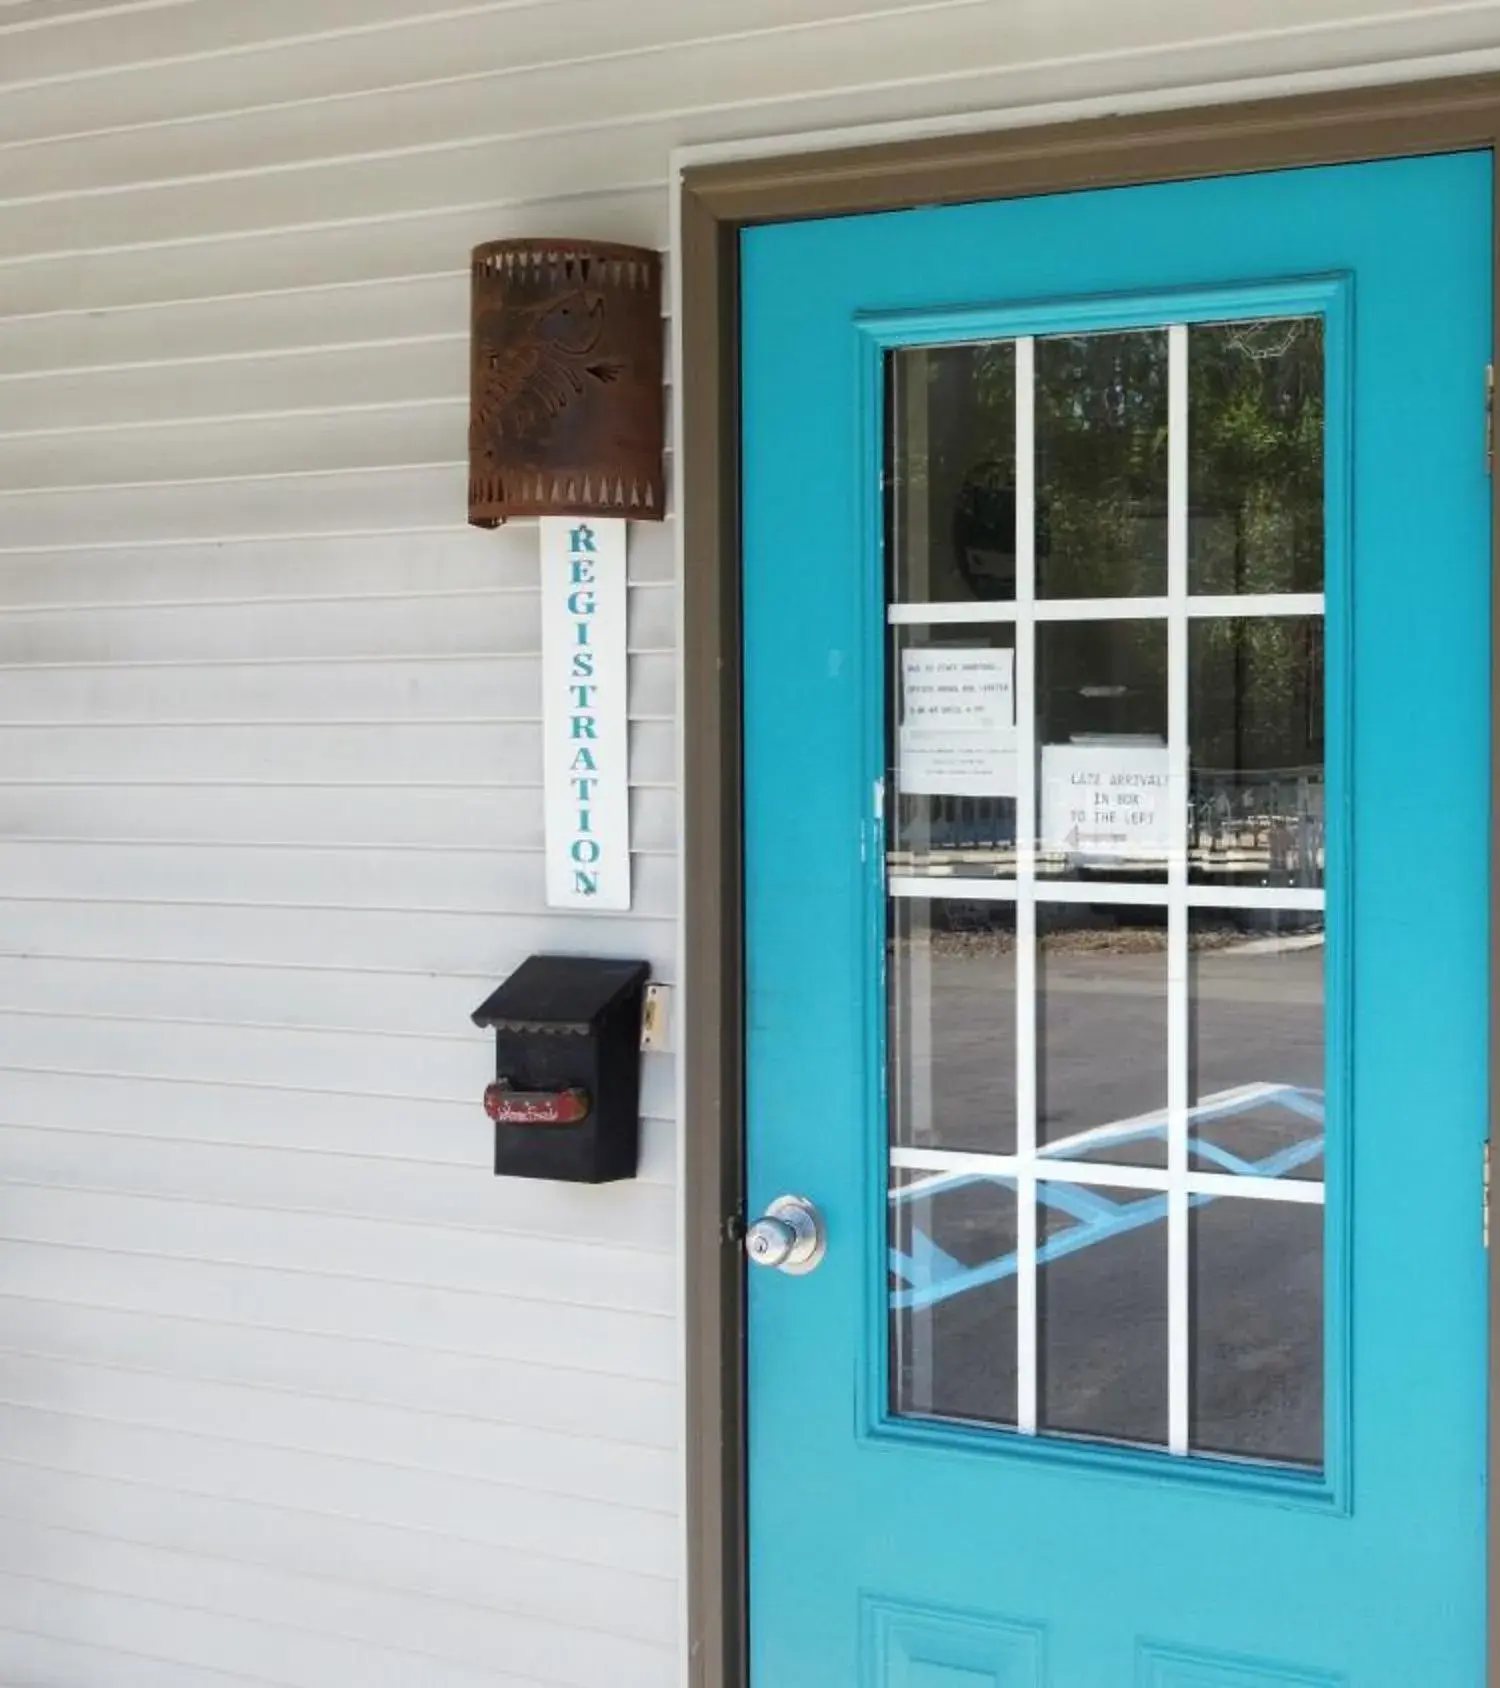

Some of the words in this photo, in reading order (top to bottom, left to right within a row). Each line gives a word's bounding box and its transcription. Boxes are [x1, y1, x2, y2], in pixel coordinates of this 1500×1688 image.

[567, 528, 601, 895] REGISTRATION
[1071, 772, 1100, 785] LATE
[1071, 810, 1085, 822] TO
[1095, 811, 1116, 823] THE
